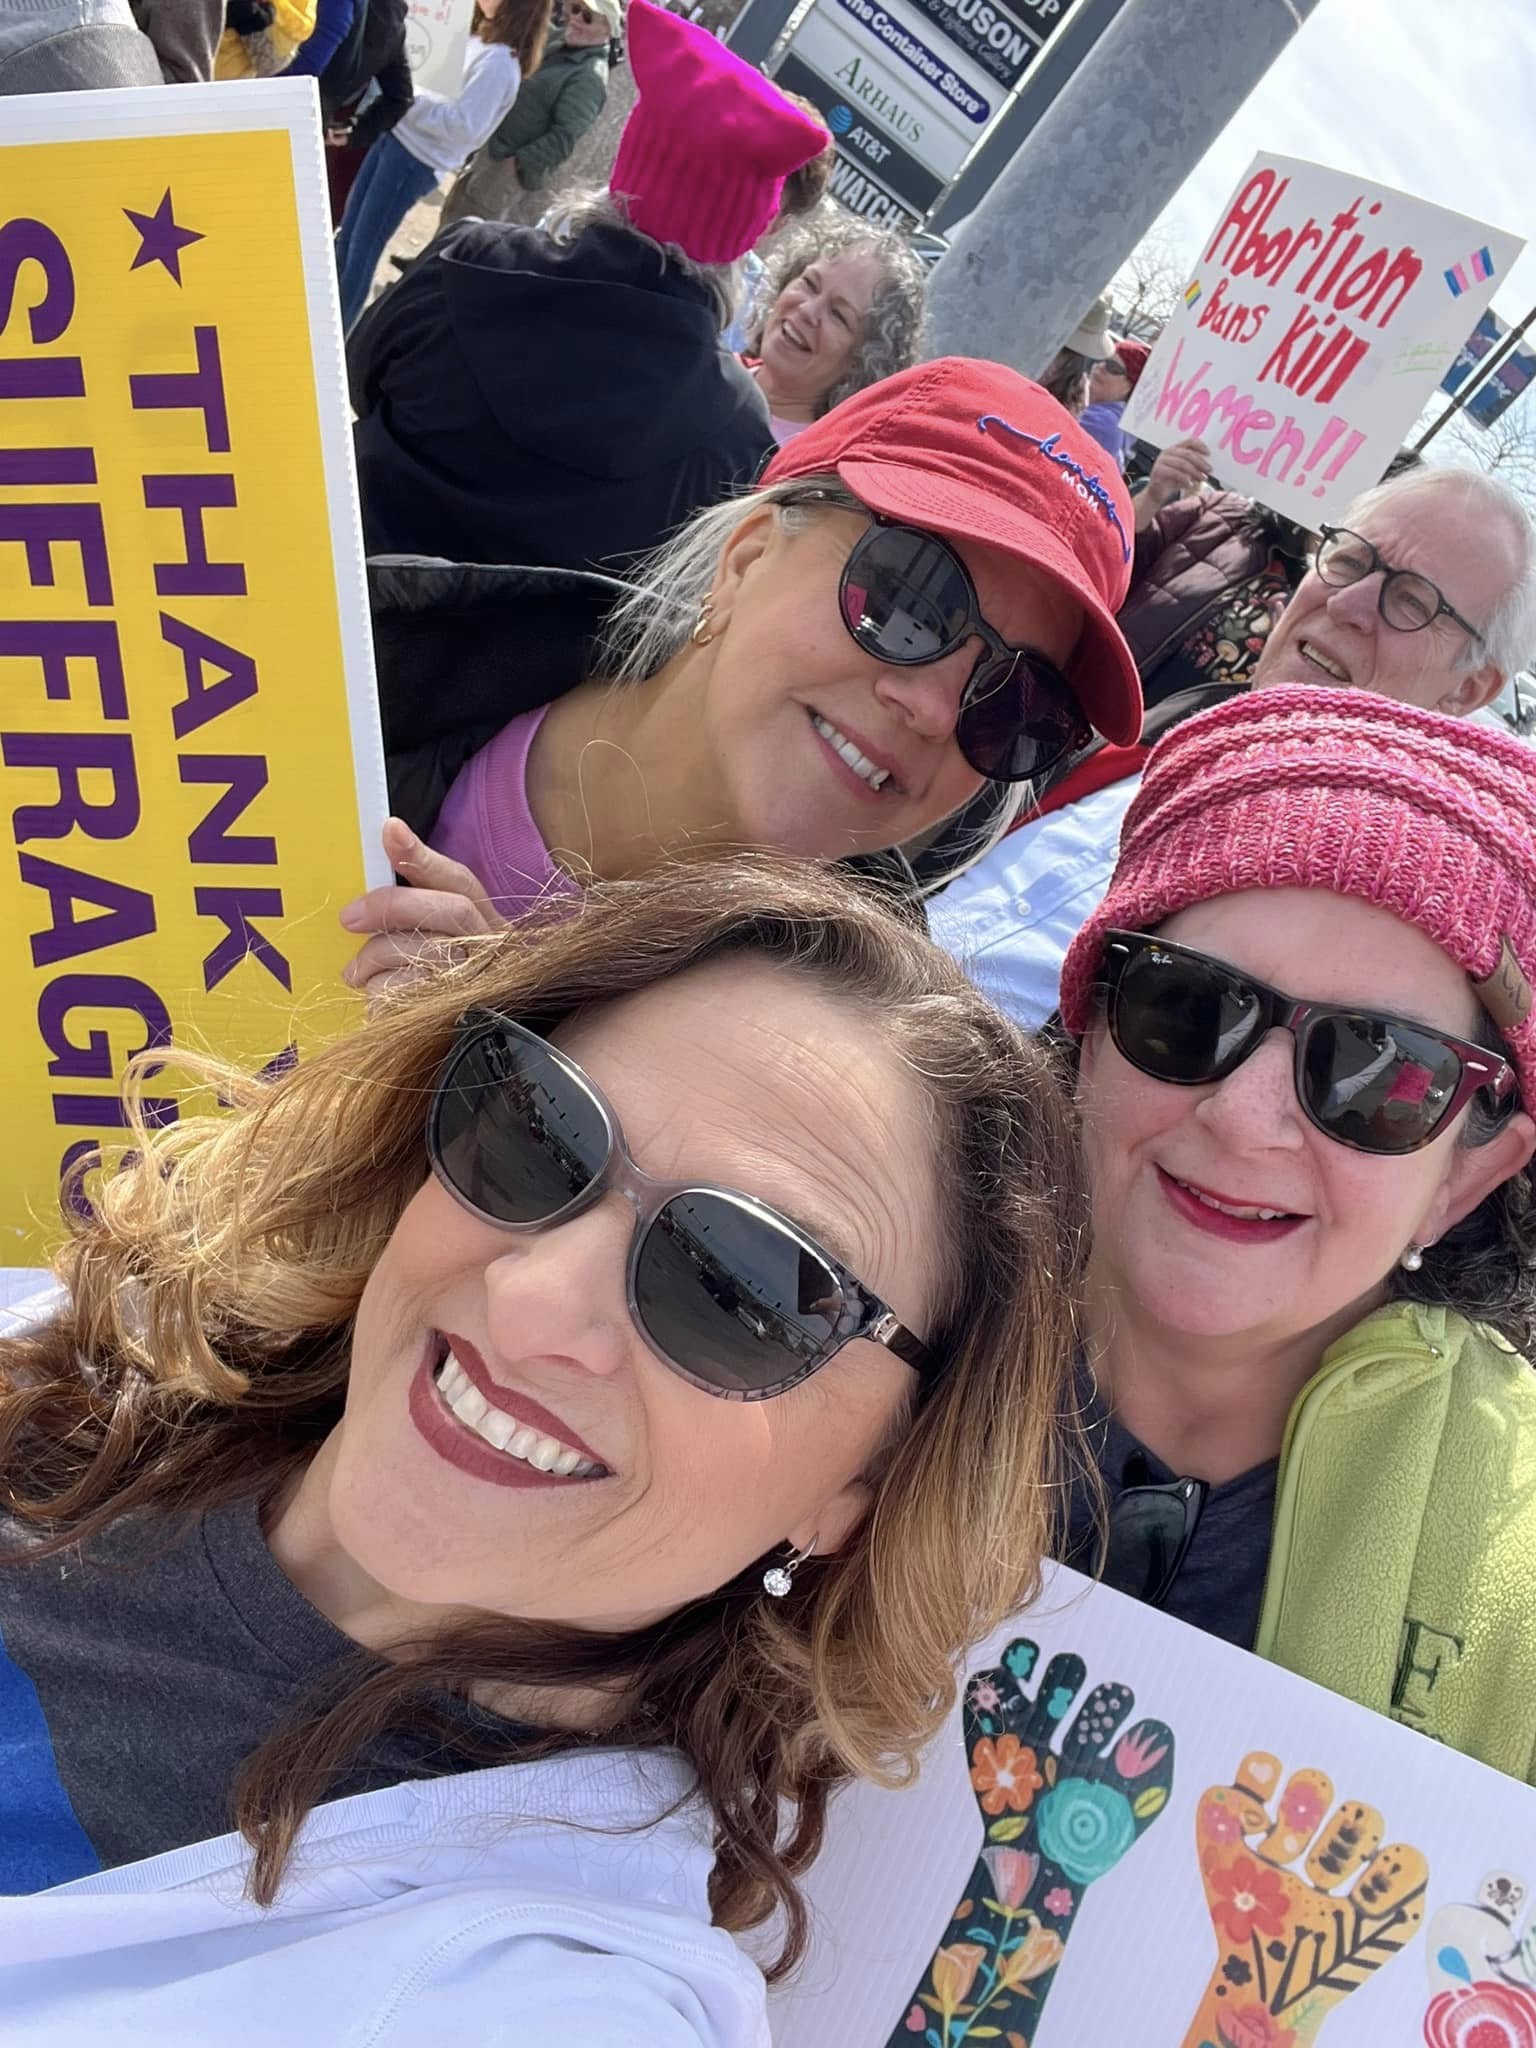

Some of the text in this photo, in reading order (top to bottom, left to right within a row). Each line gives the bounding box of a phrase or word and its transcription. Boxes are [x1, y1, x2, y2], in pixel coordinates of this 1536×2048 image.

[872, 12, 943, 80] Container
[939, 73, 980, 113] Store
[945, 0, 1030, 66] USON
[835, 57, 926, 143] ARHAUS
[847, 126, 892, 163] AT&T
[829, 157, 904, 232] WATCH
[1203, 168, 1423, 329] Abortion
[1153, 337, 1367, 498] Women!!
[1061, 470, 1099, 513] MOM
[128, 325, 293, 994] THANK
